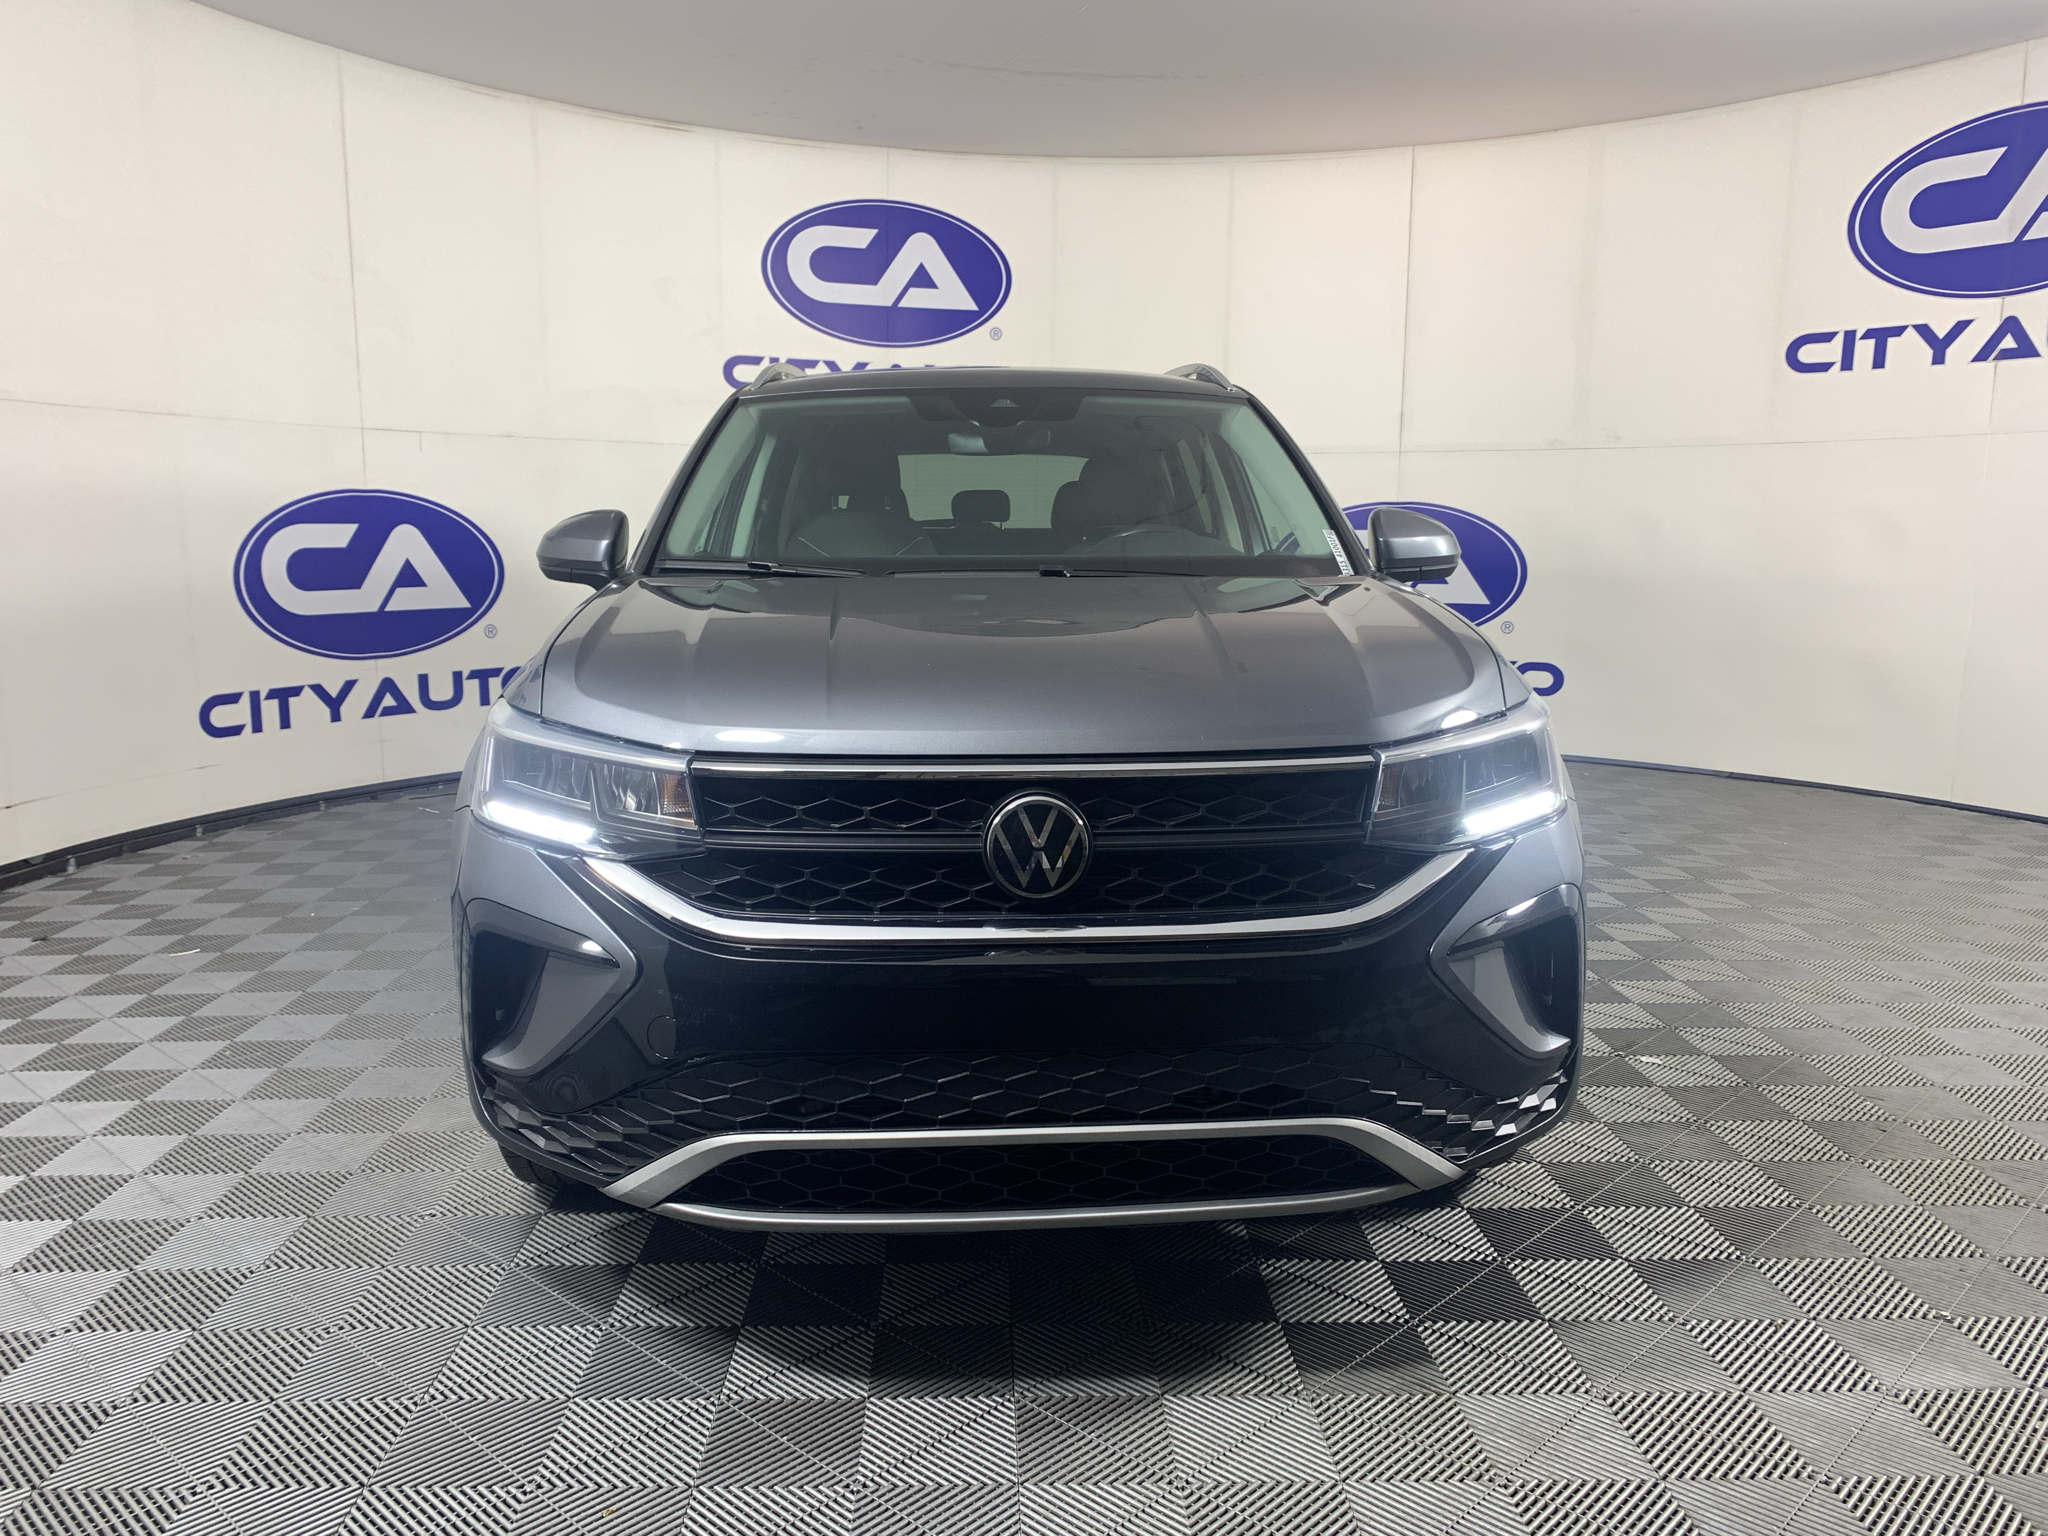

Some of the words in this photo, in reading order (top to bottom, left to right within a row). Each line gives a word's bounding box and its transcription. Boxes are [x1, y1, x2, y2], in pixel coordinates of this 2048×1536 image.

[787, 225, 979, 311] CA
[1786, 317, 1976, 374] CITY
[261, 523, 472, 616] CA
[198, 678, 359, 738] CITY
[361, 666, 522, 719] AUT
